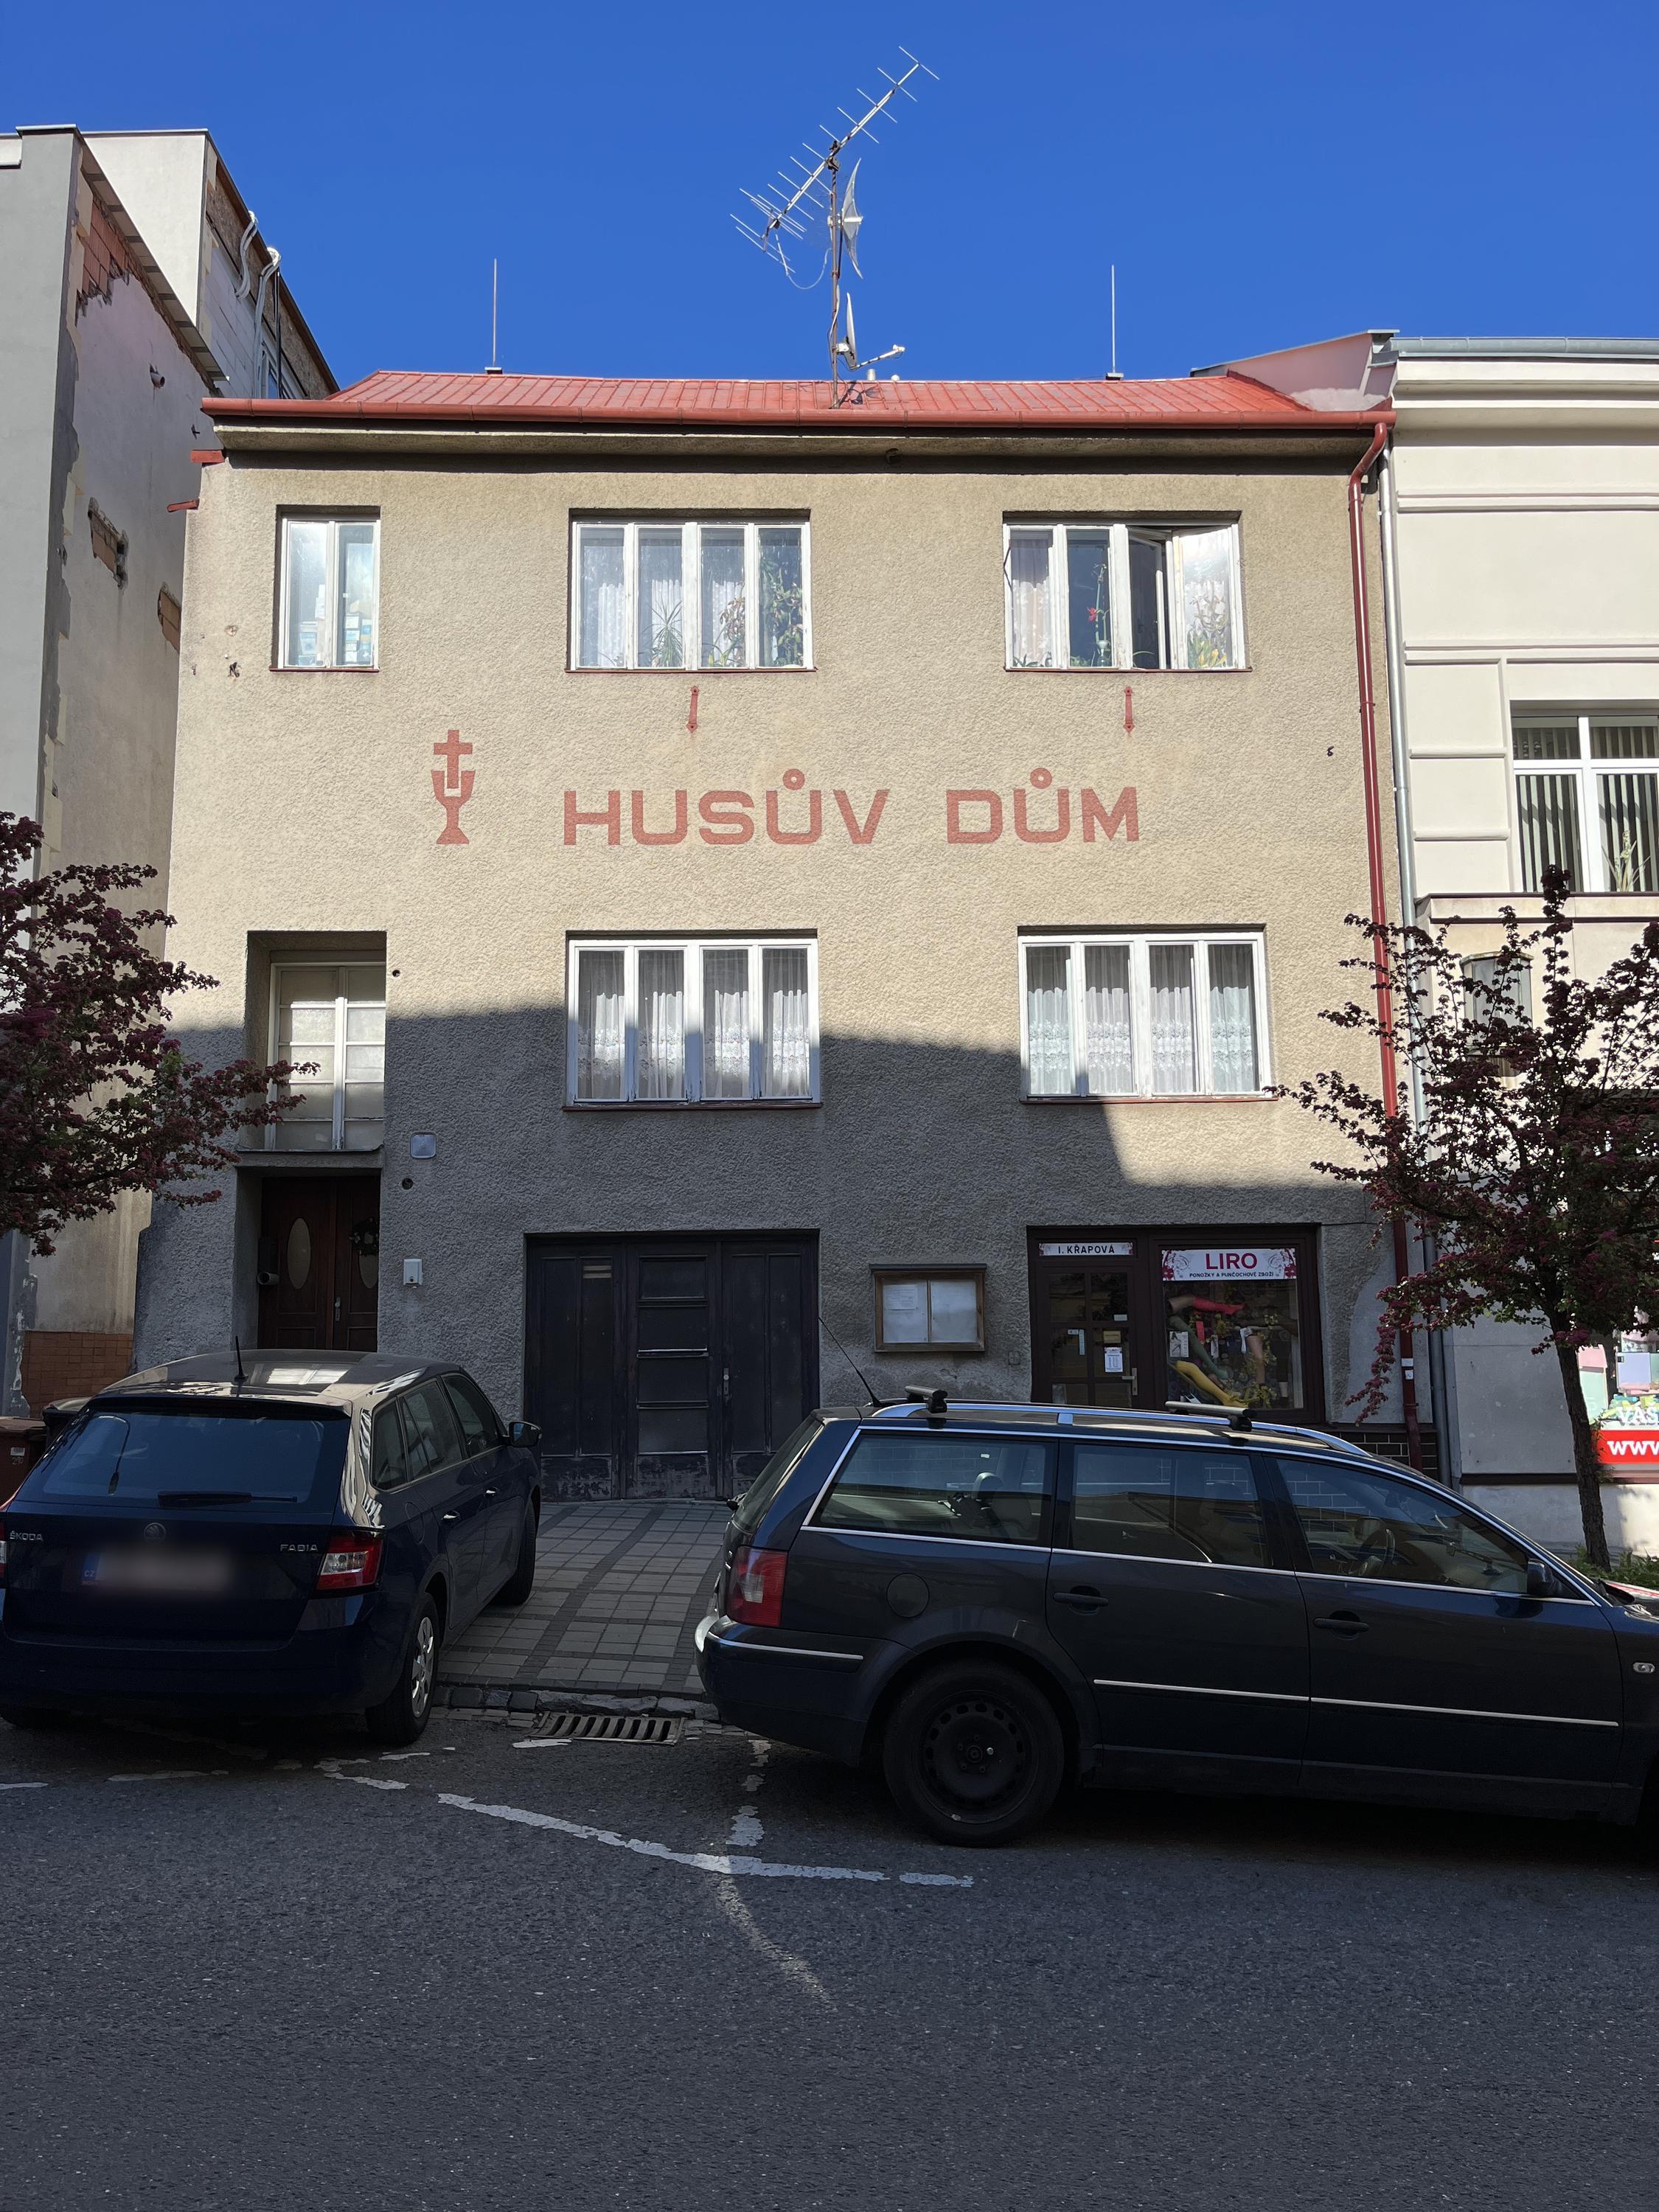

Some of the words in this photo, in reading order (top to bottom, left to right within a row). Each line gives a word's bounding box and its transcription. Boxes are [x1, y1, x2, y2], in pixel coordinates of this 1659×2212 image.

[563, 768, 889, 845] HUSŮV
[947, 767, 1139, 844] DŮM
[1058, 1245, 1065, 1253] I.
[1067, 1244, 1115, 1253] KŘAPOVÁ
[1206, 1253, 1257, 1270] LIRO
[10, 1530, 44, 1541] ŠKODA
[280, 1544, 319, 1552] FABIA
[84, 1569, 95, 1577] CZ
